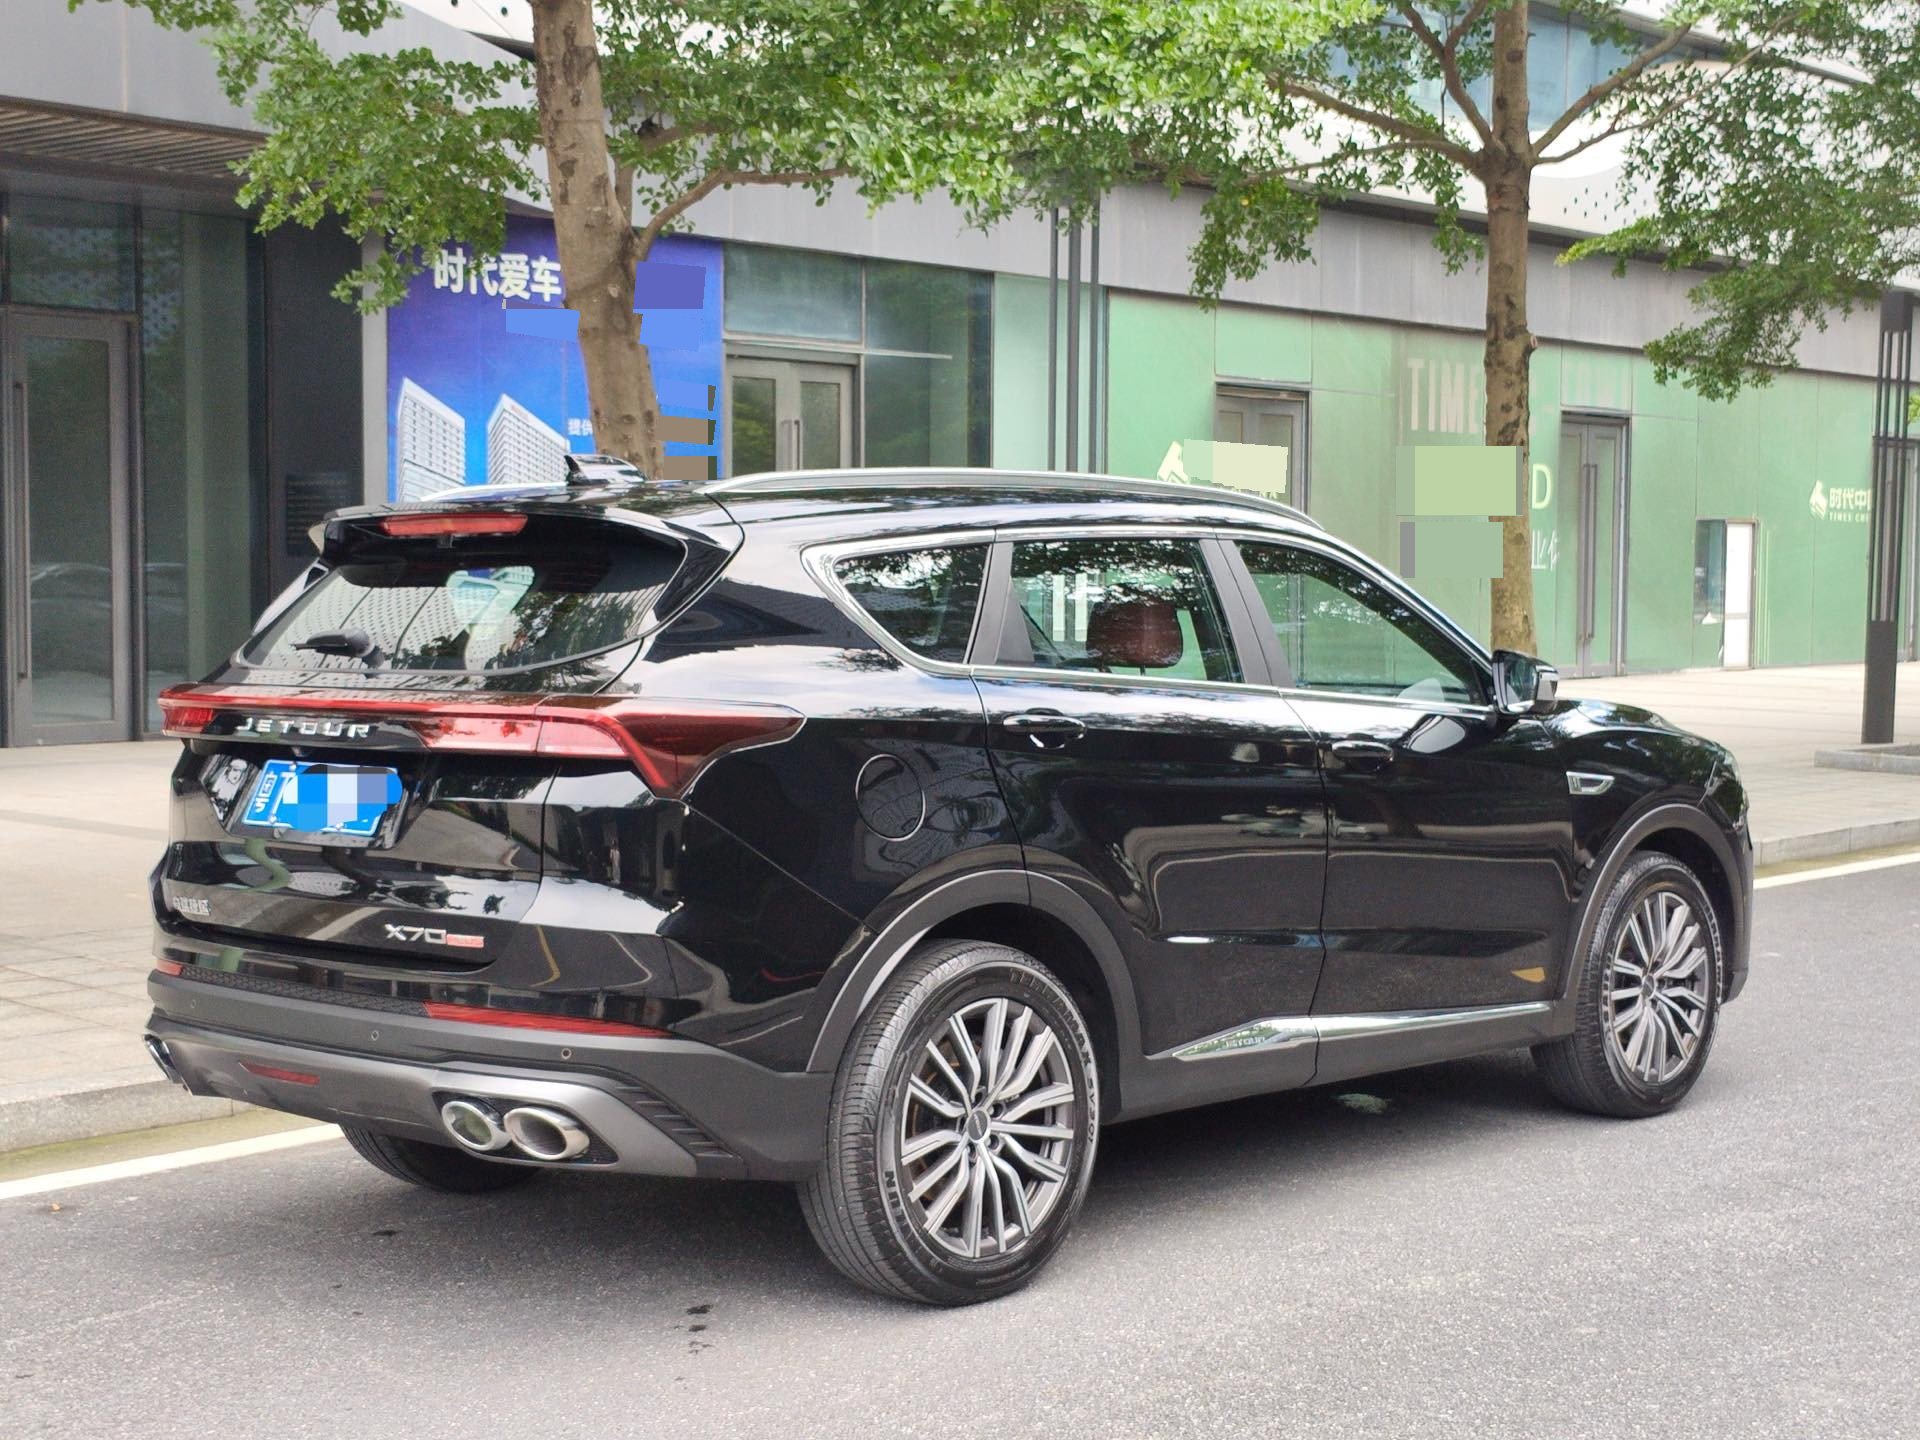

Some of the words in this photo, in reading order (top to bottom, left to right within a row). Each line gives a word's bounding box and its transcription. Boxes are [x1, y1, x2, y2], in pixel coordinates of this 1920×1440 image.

[434, 247, 562, 302] 时代爱车
[1407, 358, 1480, 433] TIME
[236, 717, 370, 739] JETOUR
[384, 923, 447, 945] X70
